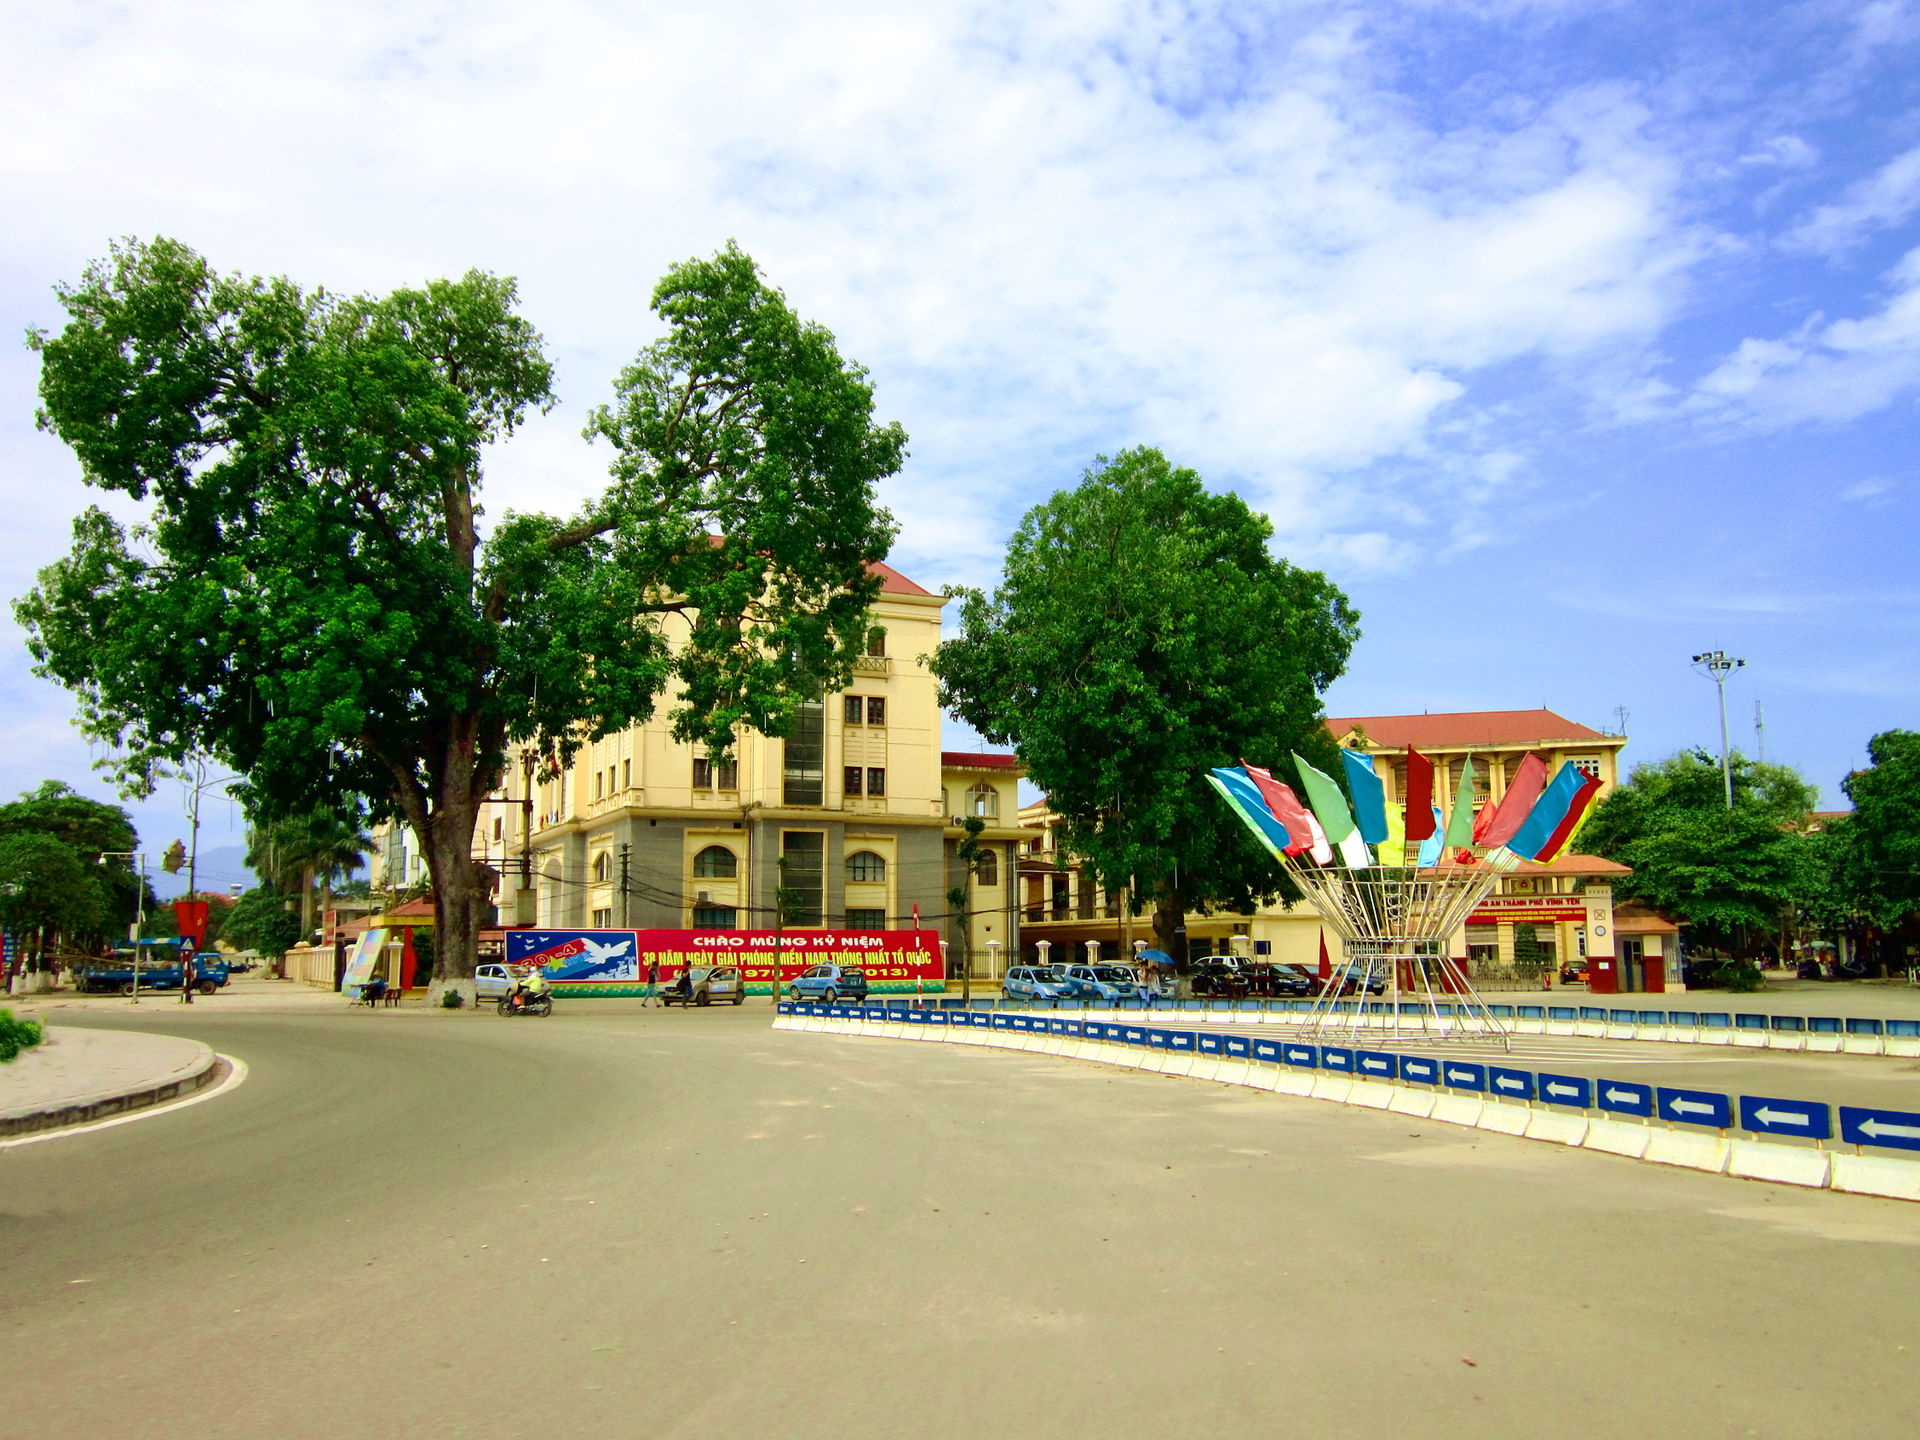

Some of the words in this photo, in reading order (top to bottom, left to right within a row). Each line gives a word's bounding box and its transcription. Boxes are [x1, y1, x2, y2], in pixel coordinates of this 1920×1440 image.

[692, 935, 745, 947] CHÀO
[840, 935, 884, 949] NIỆM
[658, 949, 684, 966] NĂM
[685, 949, 714, 966] NGÀY
[717, 946, 738, 966] GIẢI
[740, 949, 775, 966] PHÓNG
[805, 951, 829, 966] NAM
[830, 947, 863, 966] THỐNG
[864, 947, 890, 965] NHẤT
[891, 946, 904, 965] TỔ
[906, 947, 932, 966] QUỐC
